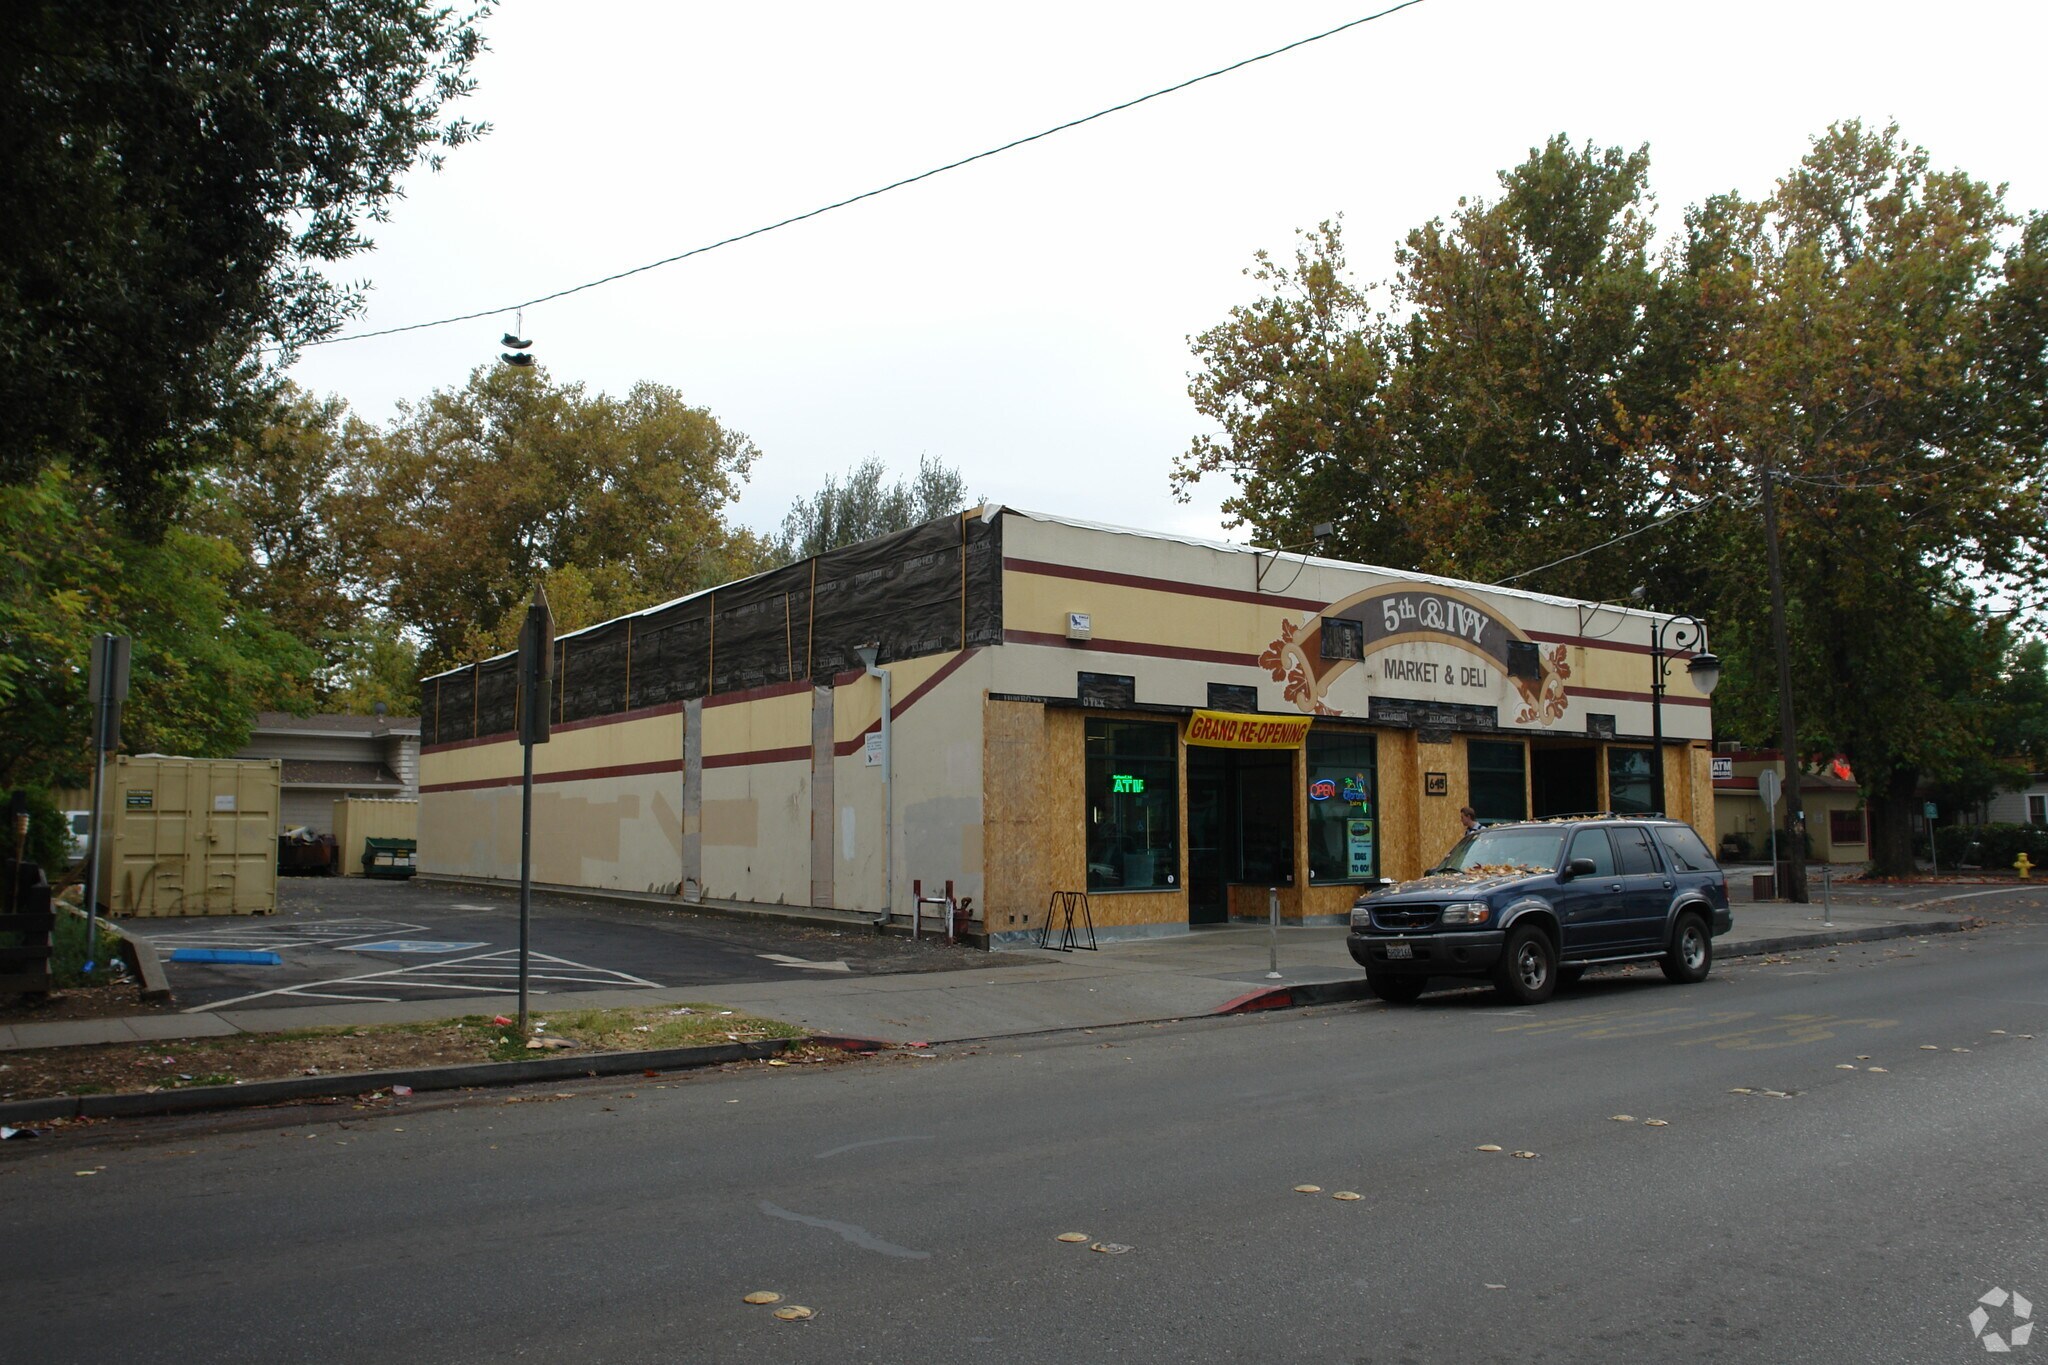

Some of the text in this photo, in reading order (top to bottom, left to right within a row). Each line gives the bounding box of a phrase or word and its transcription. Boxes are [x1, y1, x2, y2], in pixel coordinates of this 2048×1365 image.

[1382, 596, 1489, 644] 5th & IVY
[1384, 658, 1487, 688] MARKET & DELI
[1191, 717, 1308, 743] GRAND RE-OPENING
[1713, 761, 1731, 770] ATM
[1311, 783, 1335, 797] OPEN
[1429, 776, 1445, 790] 645
[1354, 852, 1367, 861] KEGS
[1351, 864, 1359, 873] TO
